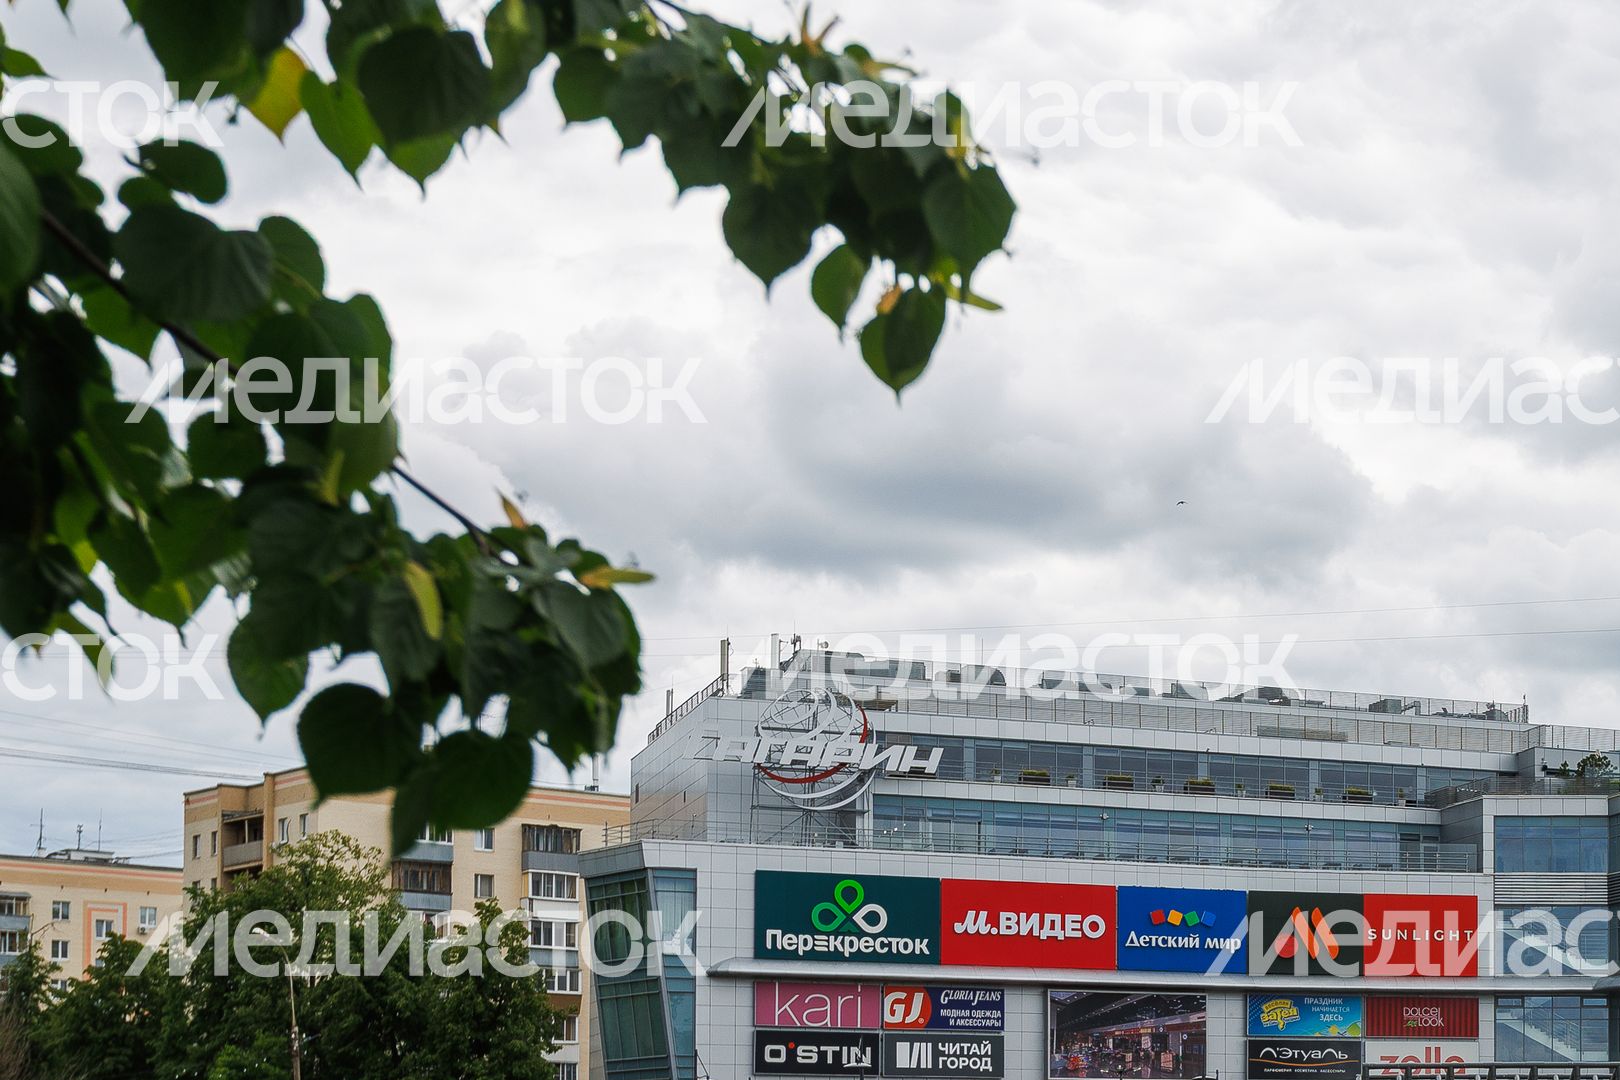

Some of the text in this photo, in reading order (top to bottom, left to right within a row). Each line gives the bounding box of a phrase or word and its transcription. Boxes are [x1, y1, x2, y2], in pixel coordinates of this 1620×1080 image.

[1125, 930, 1242, 953] Детский мир
[1368, 928, 1474, 942] SUNLIGHT
[766, 928, 930, 957] Перекресток
[775, 981, 861, 1027] kari
[1304, 997, 1343, 1006] ПРАЗДНИК
[940, 1008, 1001, 1019] МОДНАЯ ОДЕЖДА
[1319, 1013, 1343, 1021] ЗДЕСЬ
[949, 1018, 1002, 1027] И АКСЕССУАРЫ
[938, 1041, 992, 1056] ЧИТАЙ
[938, 1057, 993, 1072] ГОРОД
